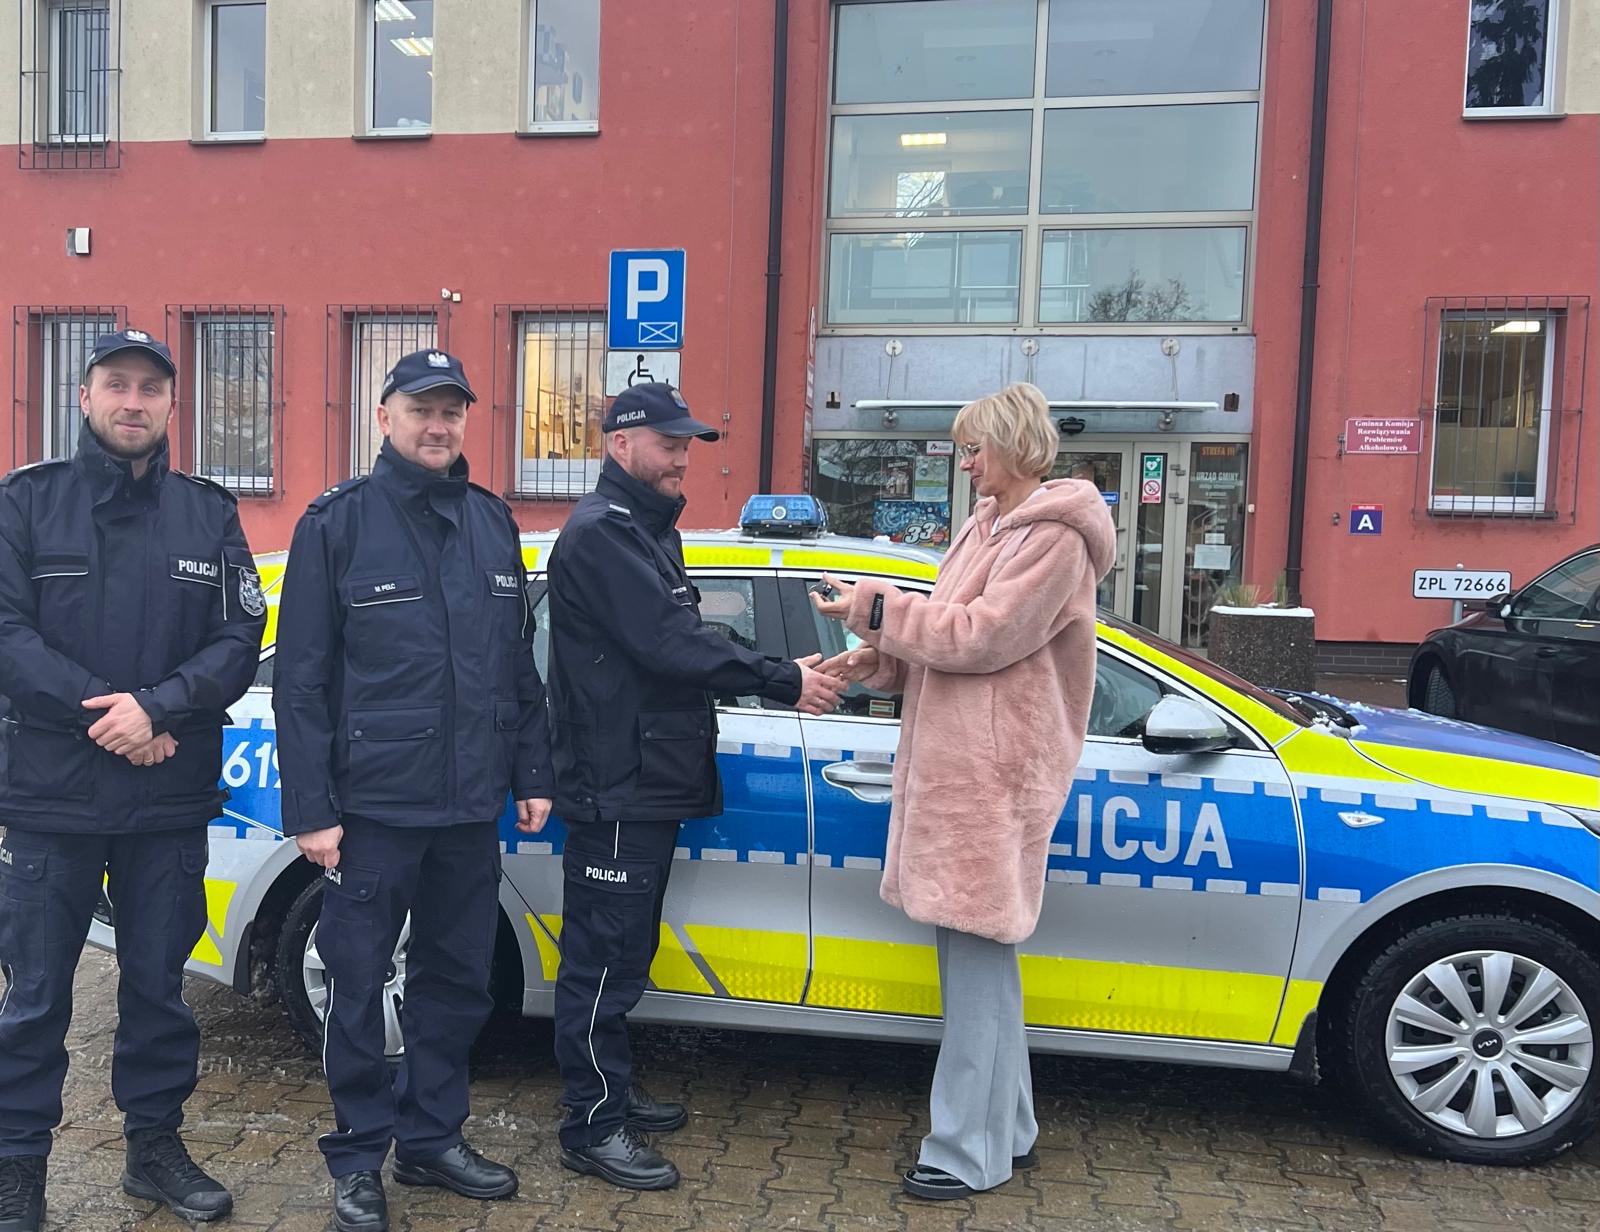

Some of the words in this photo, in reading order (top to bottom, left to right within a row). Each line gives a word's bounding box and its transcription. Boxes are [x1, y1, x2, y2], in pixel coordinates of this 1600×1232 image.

[626, 258, 669, 320] P
[616, 409, 647, 424] POLICJA
[1385, 420, 1414, 428] Komisja
[1359, 444, 1408, 453] Alkoholowych
[1357, 513, 1375, 531] A
[904, 520, 937, 544] 33
[1418, 577, 1447, 591] ZPL
[1454, 577, 1506, 592] 72666
[585, 866, 628, 883] POLICJA
